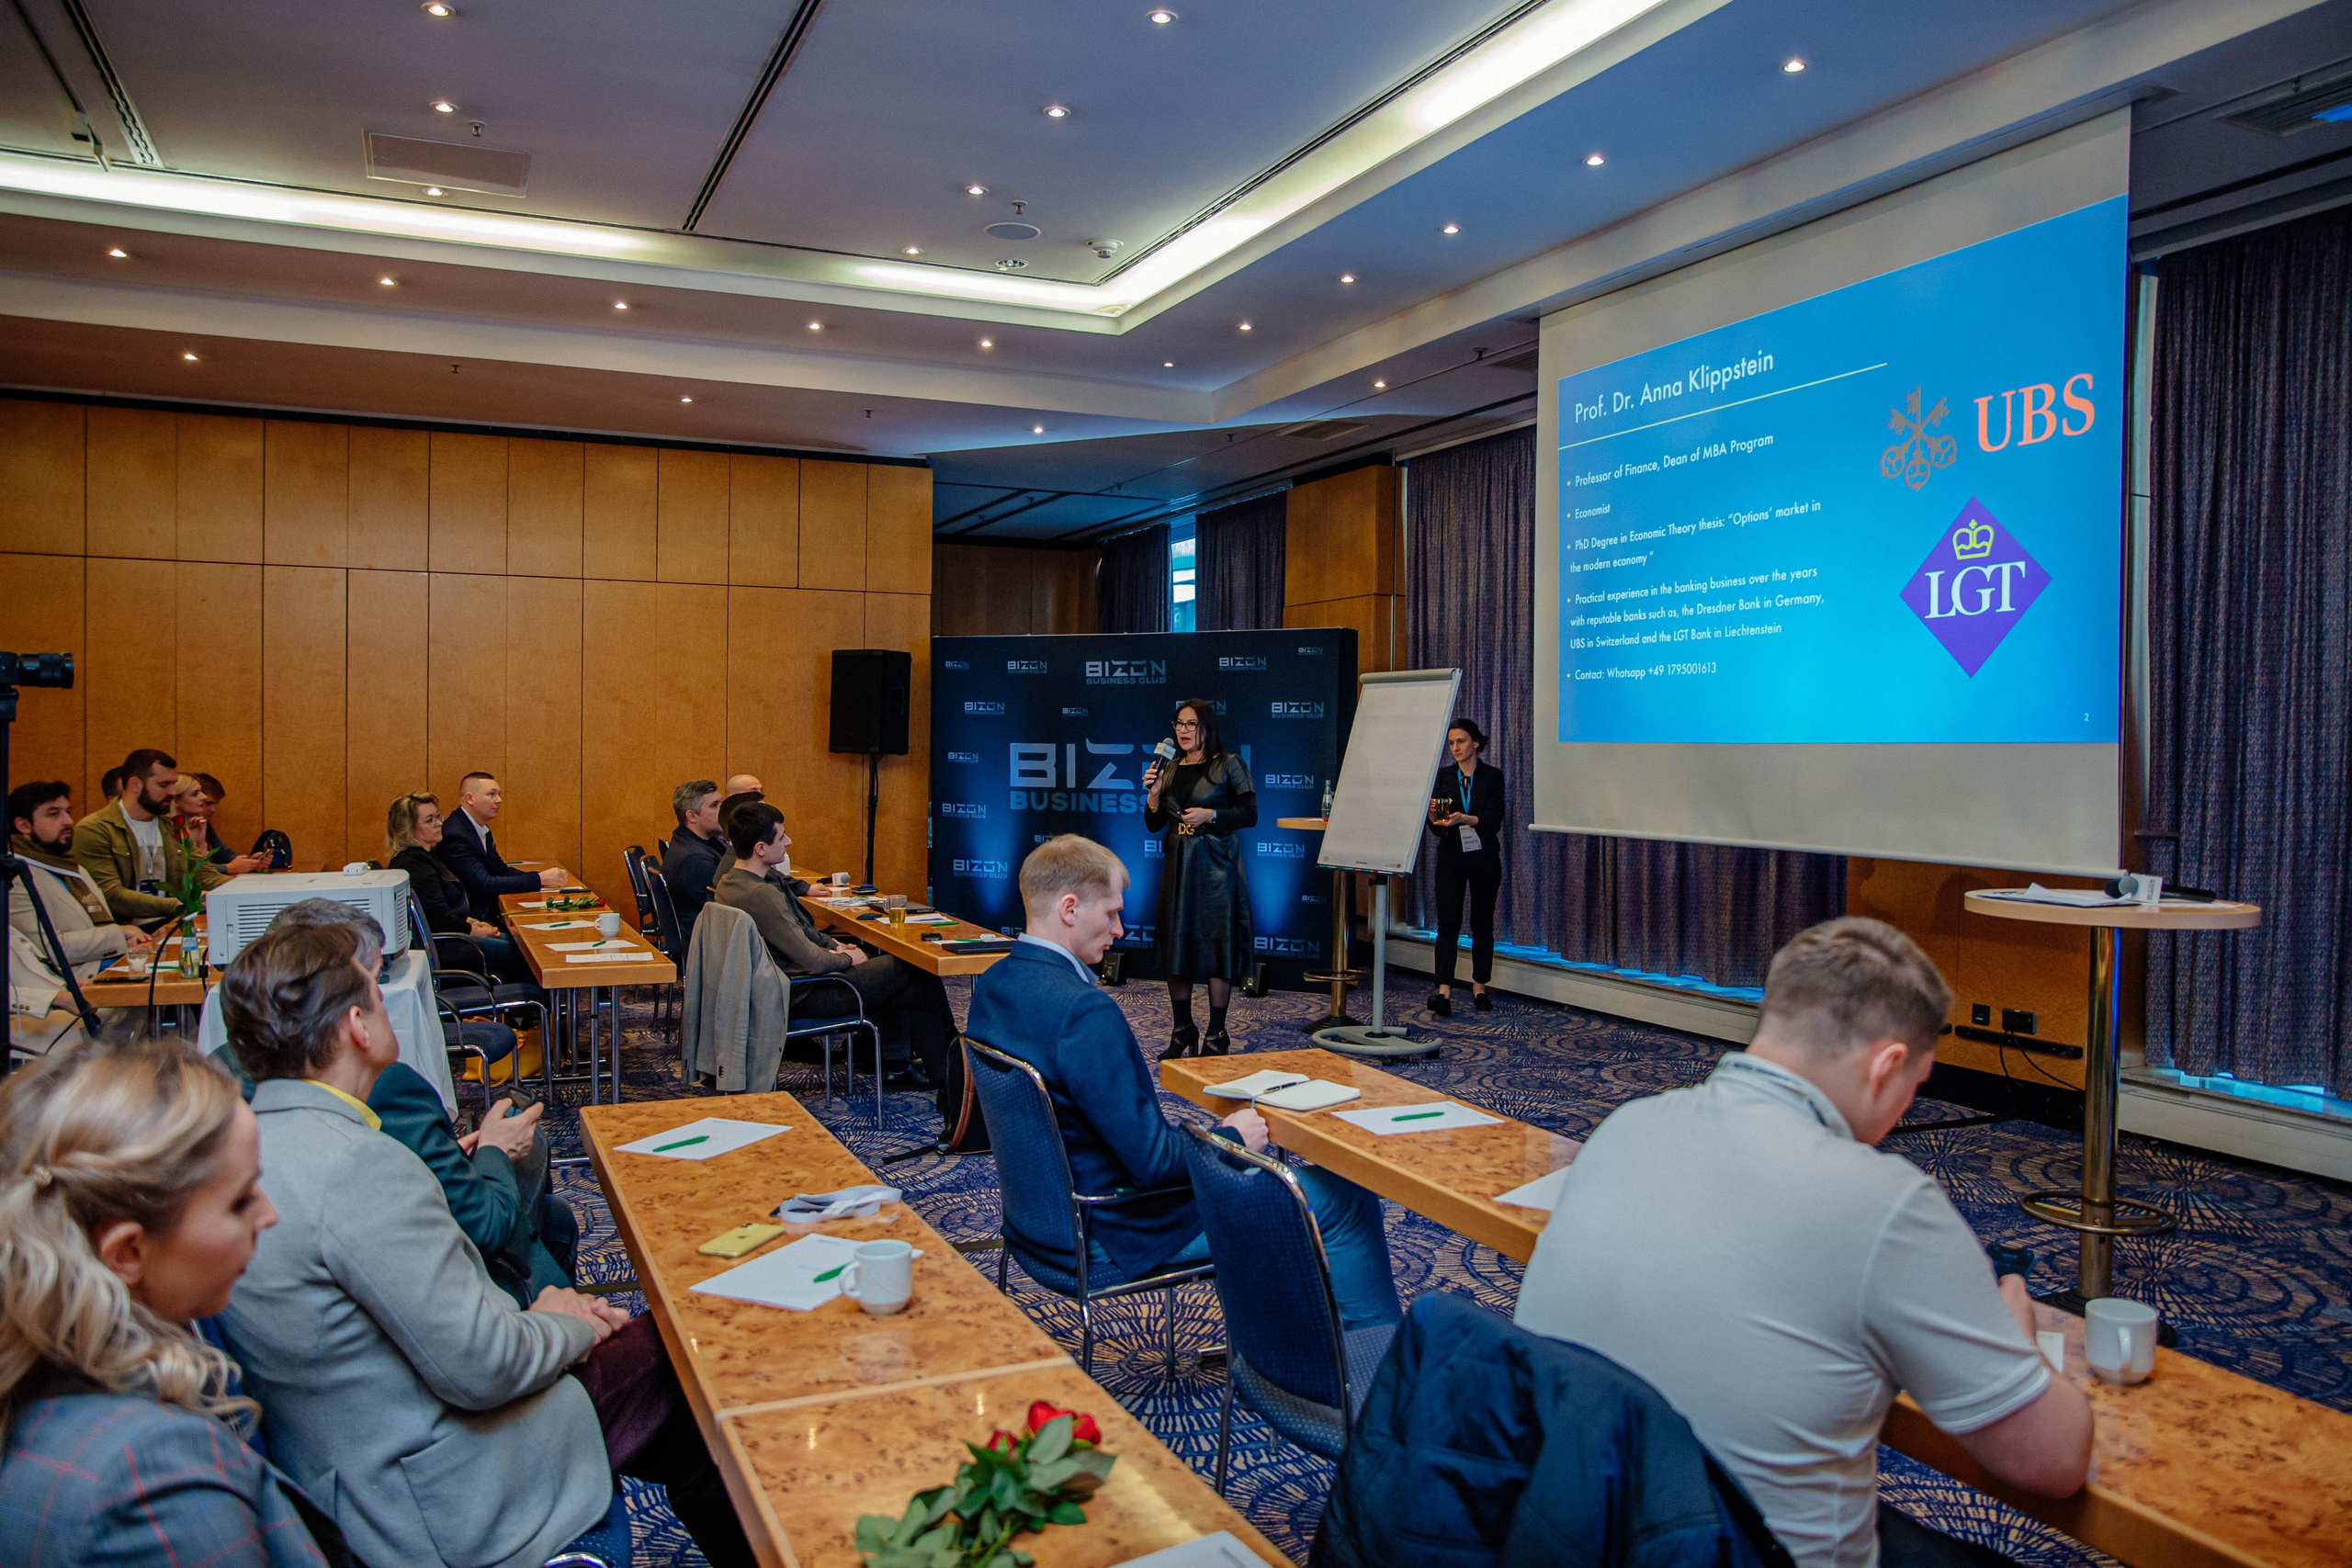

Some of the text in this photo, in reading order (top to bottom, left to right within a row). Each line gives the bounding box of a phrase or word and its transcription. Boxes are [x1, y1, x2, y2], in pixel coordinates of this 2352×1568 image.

[1575, 349, 1774, 423] Prof. Dr. Anna Klippstein
[1973, 373, 2096, 453] UBS
[1575, 434, 1774, 487] Professor of Finance, Dean of MBA Program
[1575, 503, 1611, 519] Economist
[1575, 538, 1589, 550] PhD
[1590, 536, 1619, 550] Degree
[1620, 533, 1628, 544] in
[1629, 525, 1667, 542] Economic
[1668, 523, 1697, 536] Theory
[1698, 516, 1725, 531] thesis:
[1775, 501, 1809, 518] market
[1811, 499, 1822, 512] in
[1570, 561, 1581, 573] the
[1583, 558, 1611, 571] modern
[1612, 555, 1648, 568] economy
[1575, 568, 1818, 604] Practical experience in the banking business over the years
[1925, 561, 2026, 619] LGT
[1569, 593, 1825, 627] with reputable banks such as, the Dresdner Bank in Germany,
[1570, 621, 1782, 649] UBS in Switzerland and the LGT Bank in Liechtenstein
[1007, 660, 1048, 670] BIZON
[1085, 660, 1167, 677] BIZON
[1219, 657, 1267, 667] BIZON
[1575, 661, 1717, 681] Contact: Whatsapp +49 1795001613
[1086, 676, 1167, 685] BUSINESS CLUB
[965, 701, 1005, 711] BIZON
[1272, 701, 1325, 714] BIZON
[2083, 713, 2090, 722] 2
[948, 752, 978, 761] BIZON
[1265, 773, 1315, 784] BIZON
[942, 803, 987, 814] BIZON
[1258, 842, 1306, 853] BIZON
[953, 859, 1008, 873] BIZON
[1254, 936, 1320, 953] BIZON
